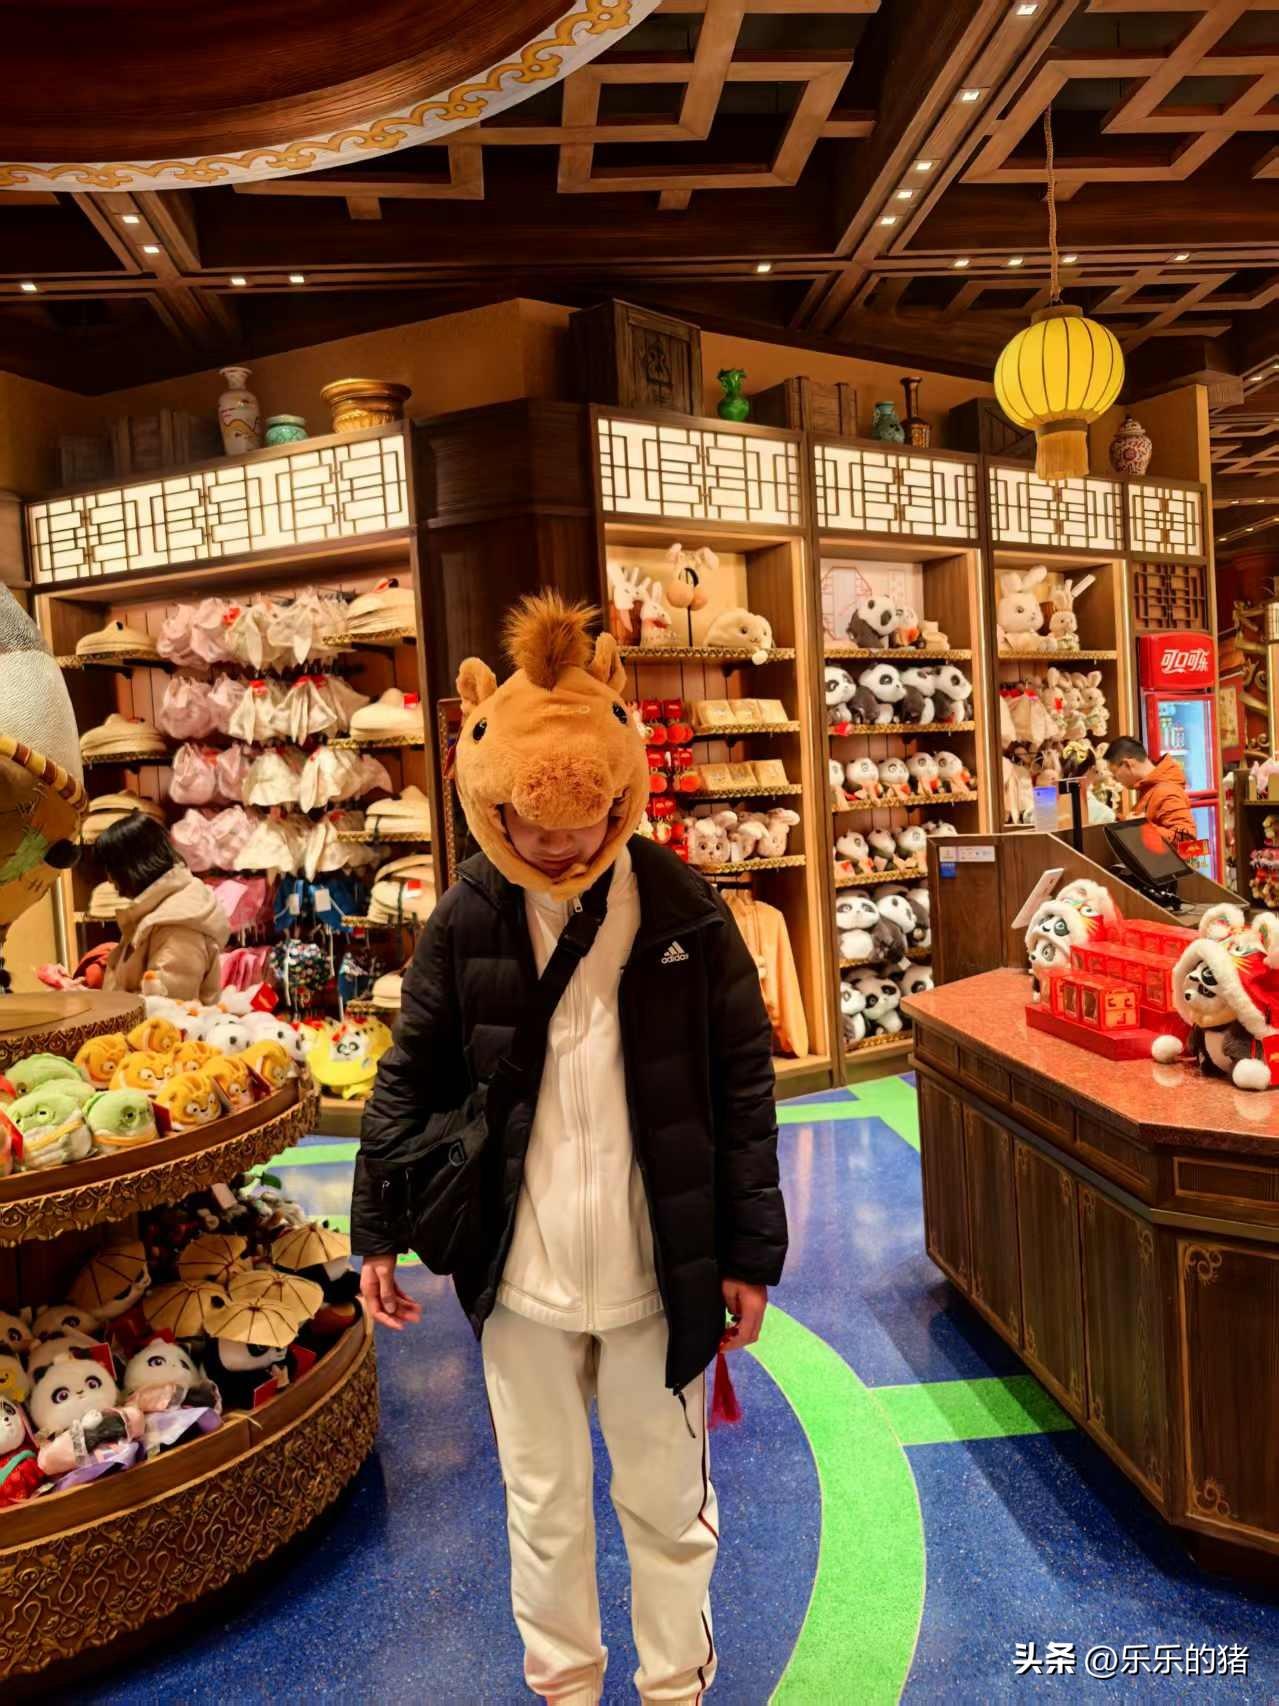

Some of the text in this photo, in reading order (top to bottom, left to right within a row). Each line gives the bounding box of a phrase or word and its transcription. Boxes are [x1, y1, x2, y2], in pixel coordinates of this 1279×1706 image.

[1161, 648, 1209, 673] 可口可乐
[661, 953, 689, 964] adidas
